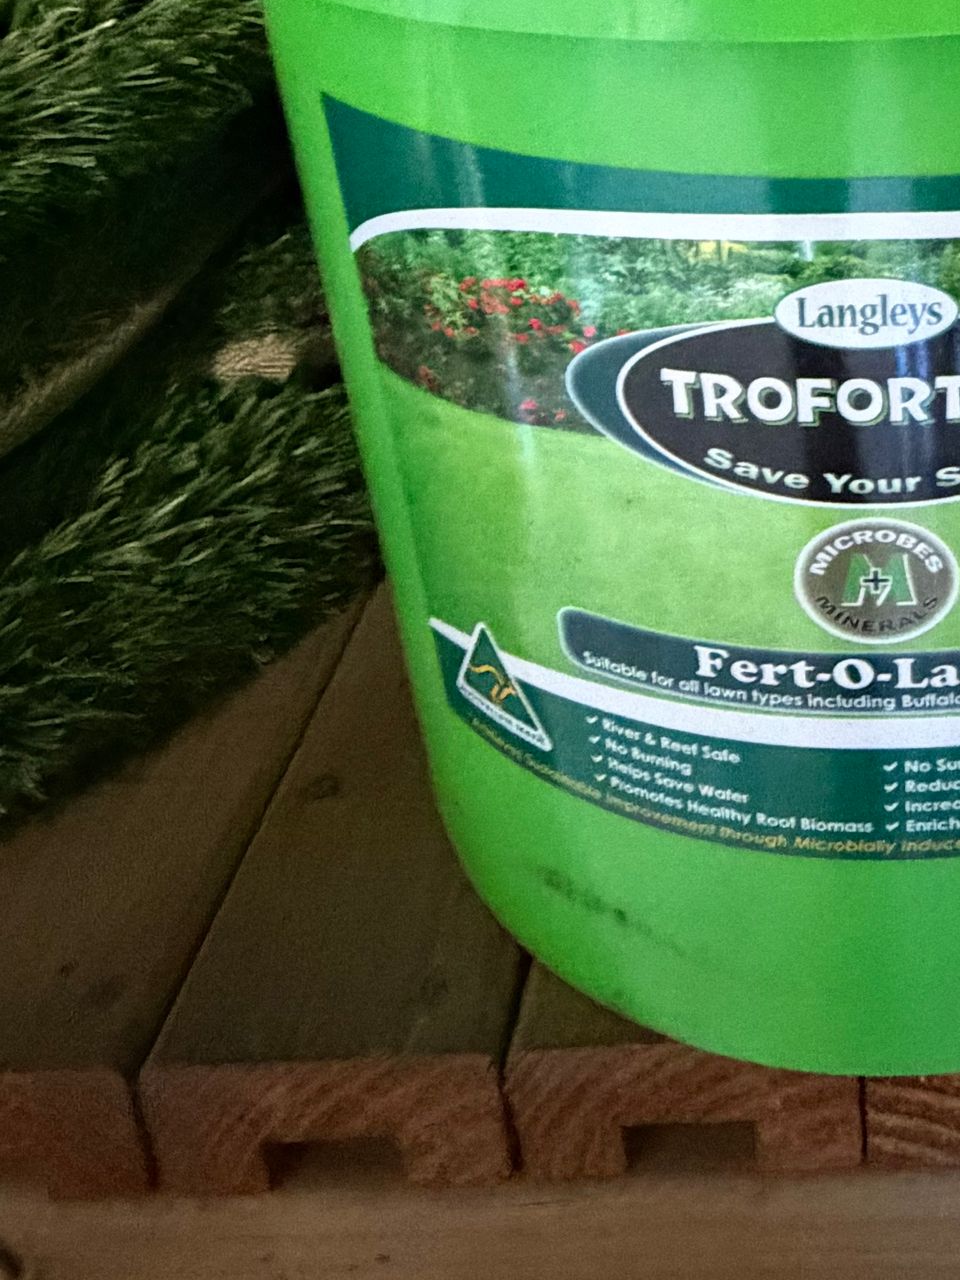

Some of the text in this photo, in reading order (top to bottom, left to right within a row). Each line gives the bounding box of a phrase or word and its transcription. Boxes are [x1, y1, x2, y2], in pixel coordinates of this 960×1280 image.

[797, 290, 943, 334] Langleys
[702, 446, 809, 491] Save
[823, 471, 921, 496] Your
[809, 529, 943, 576] MICROBES
[815, 595, 938, 632] MINERALS
[582, 650, 647, 682] Suitable
[651, 671, 674, 688] for
[679, 679, 700, 694] all
[703, 682, 748, 701] lawn
[751, 690, 802, 709] types
[807, 693, 896, 712] including
[602, 718, 742, 764] River & Reef Safe
[604, 737, 692, 776] No Burning
[607, 756, 750, 804] Helps Save Water
[904, 760, 932, 774] No
[610, 776, 875, 834] Promotes Healthy Root Biomass
[720, 826, 787, 848] through
[794, 835, 897, 855] Microbially
